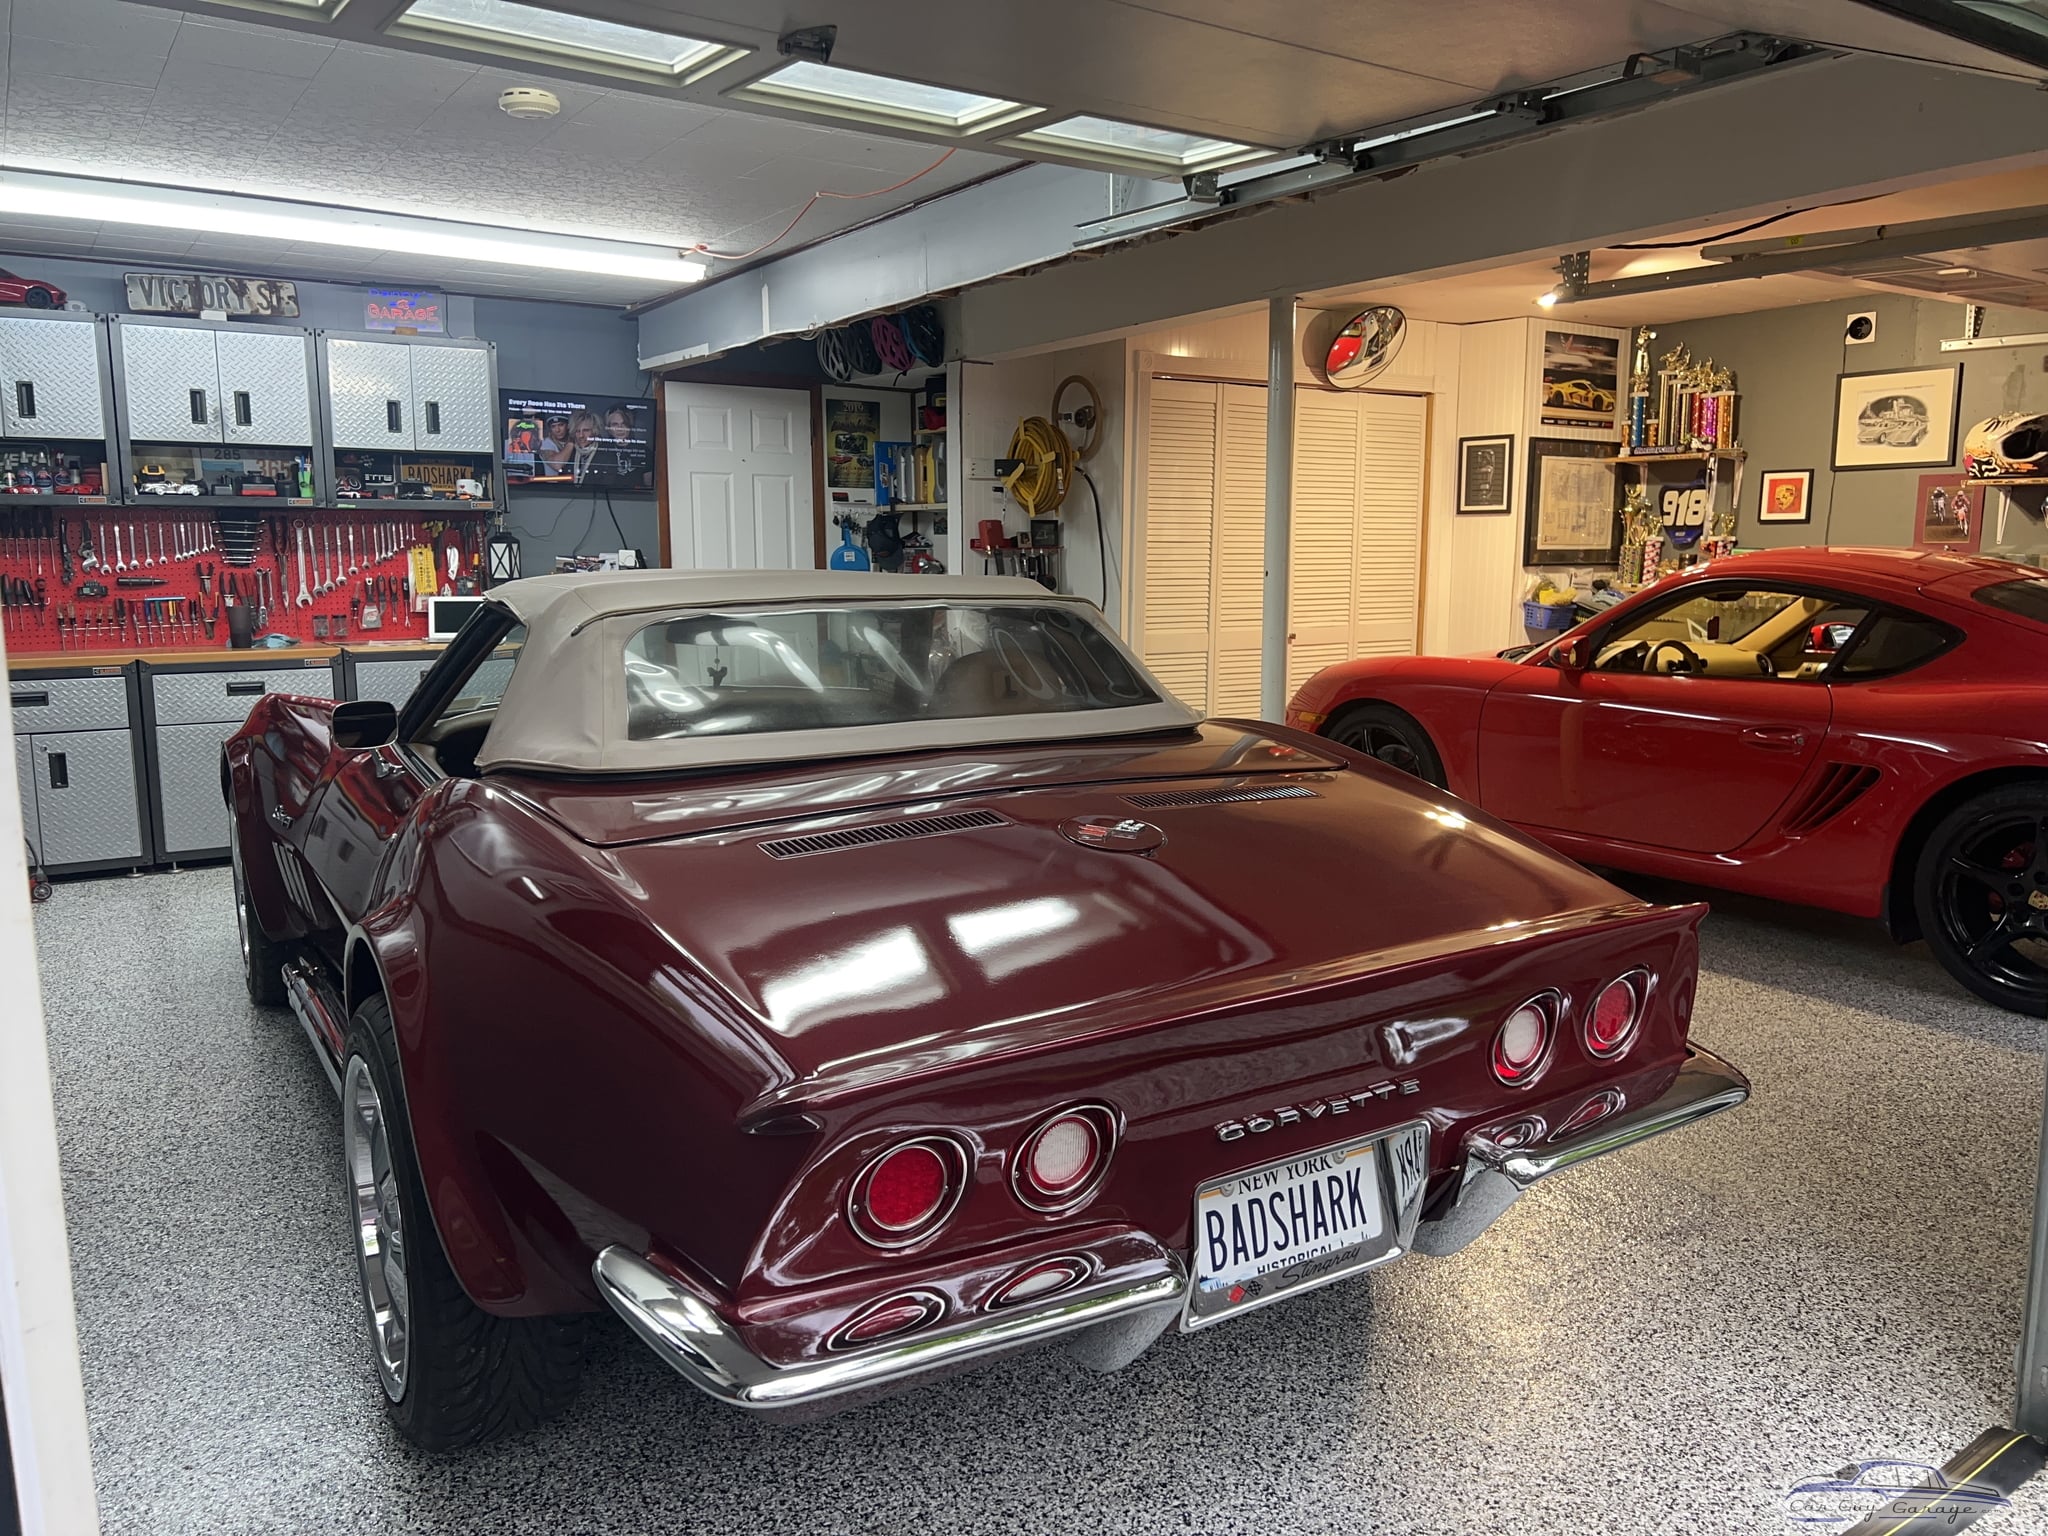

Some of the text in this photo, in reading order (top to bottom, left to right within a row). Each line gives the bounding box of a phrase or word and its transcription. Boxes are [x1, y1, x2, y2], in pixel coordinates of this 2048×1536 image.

[138, 276, 250, 310] VICTORY
[367, 303, 440, 321] GARAGE
[508, 399, 527, 407] Every
[843, 403, 864, 412] 2019
[214, 449, 241, 460] 285
[408, 466, 467, 485] BADSHARK
[1662, 489, 1707, 527] 918
[1217, 1078, 1421, 1142] CORVETTE
[1238, 1154, 1333, 1195] NEW YORK
[1206, 1167, 1367, 1272] BADSHARK
[1275, 1246, 1361, 1290] Stingray
